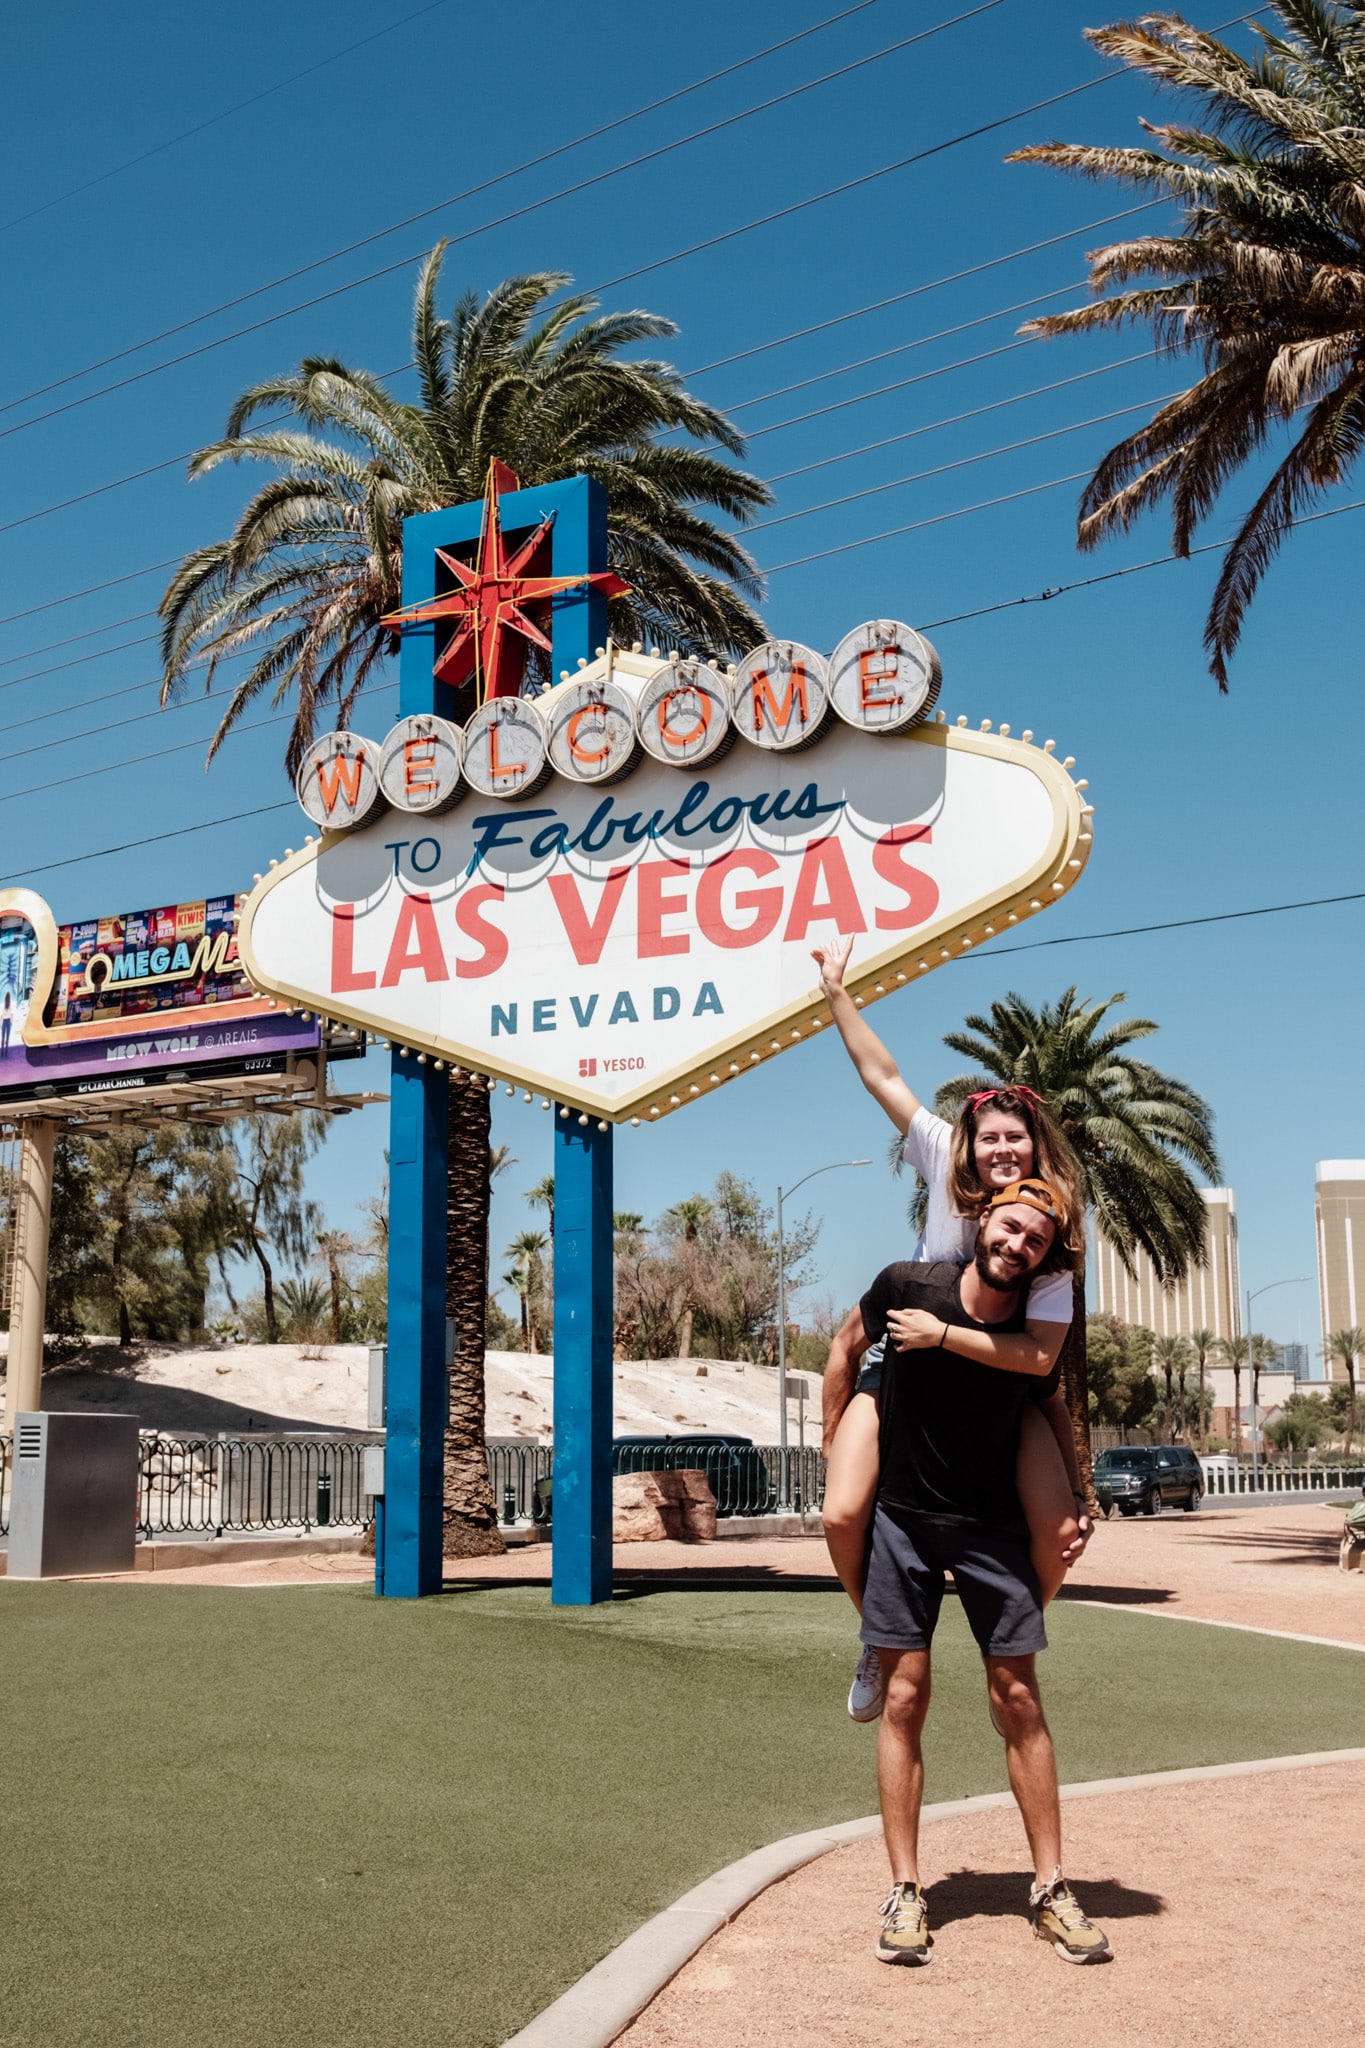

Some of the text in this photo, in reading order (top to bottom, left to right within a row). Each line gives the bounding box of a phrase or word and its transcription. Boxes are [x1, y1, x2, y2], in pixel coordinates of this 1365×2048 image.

[313, 646, 904, 814] WELCOME
[385, 781, 848, 878] TO Fabulous
[177, 910, 205, 926] KIWIS
[331, 824, 940, 993] LAS VEGAS
[490, 981, 724, 1037] NEVADA
[106, 1041, 152, 1062] MEOW
[154, 1035, 199, 1055] WOLF
[204, 1035, 215, 1049] @
[603, 1057, 645, 1072] YESCO
